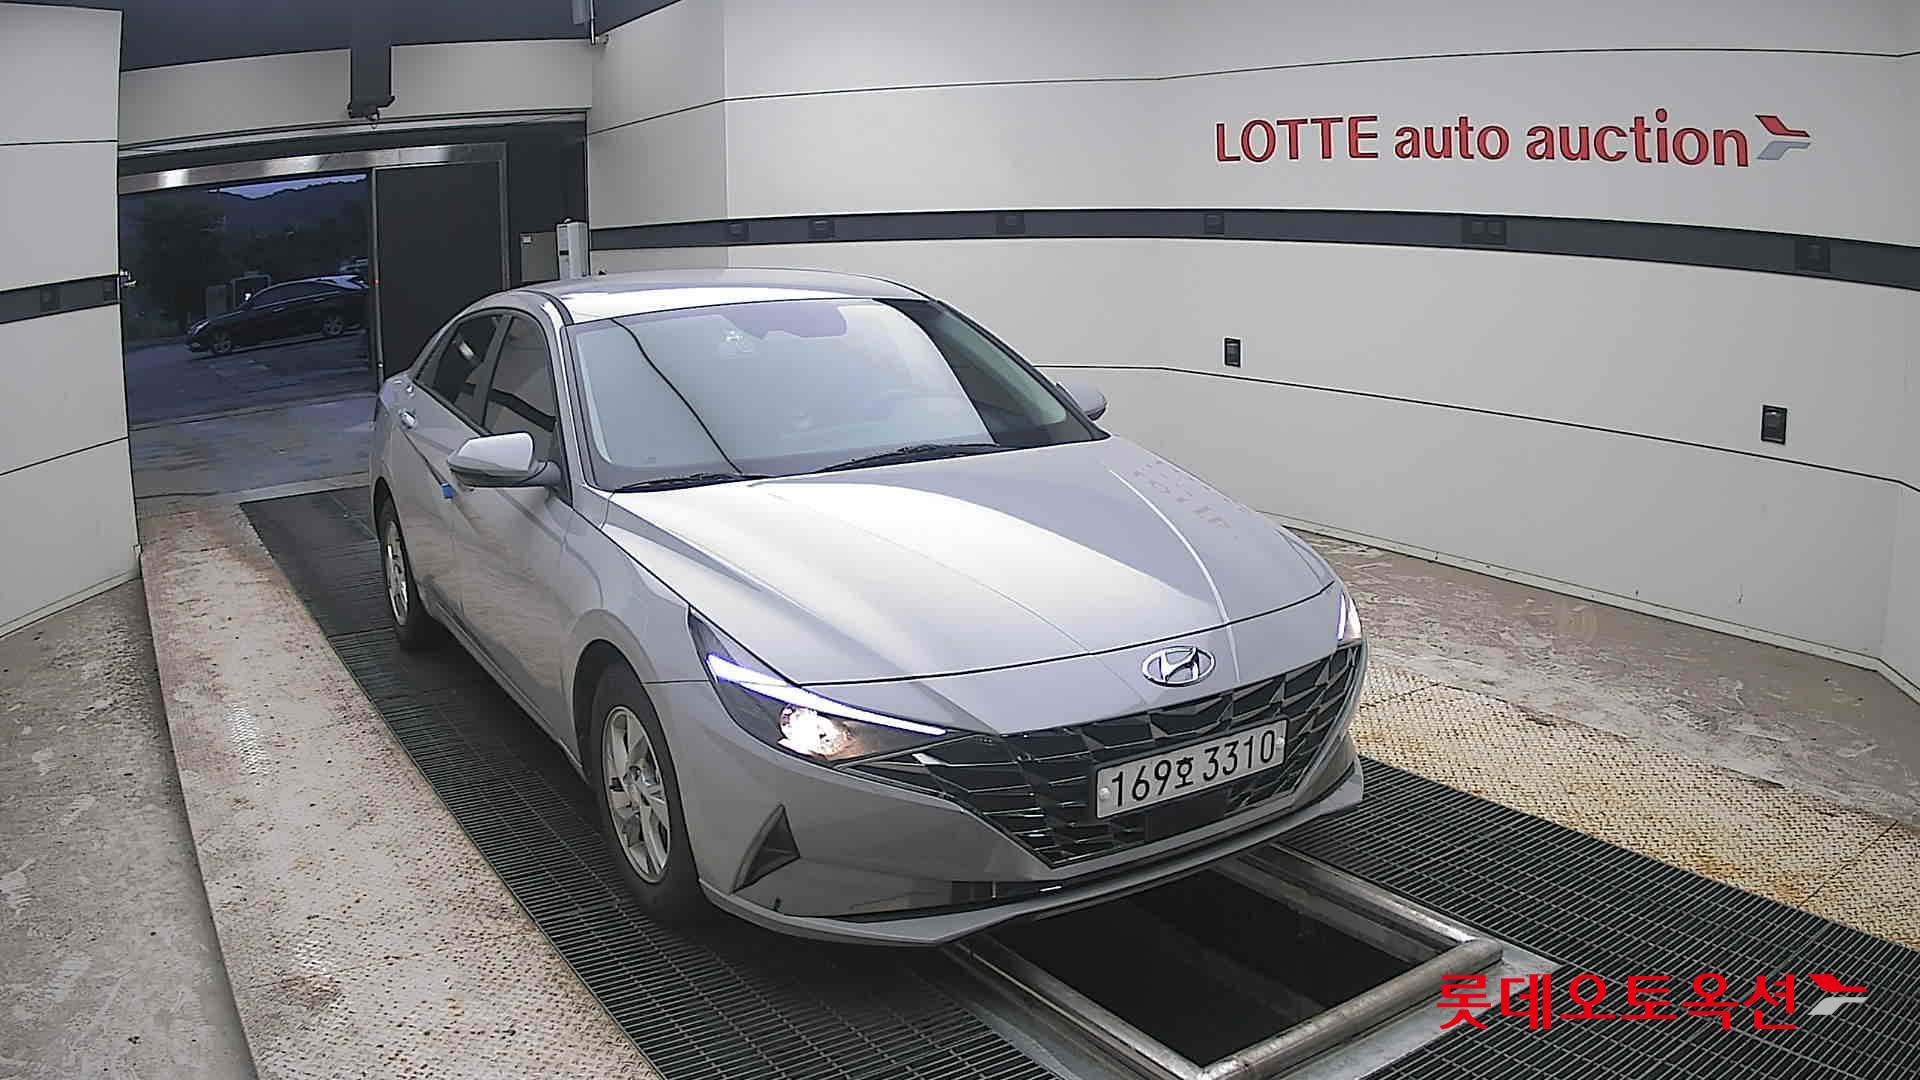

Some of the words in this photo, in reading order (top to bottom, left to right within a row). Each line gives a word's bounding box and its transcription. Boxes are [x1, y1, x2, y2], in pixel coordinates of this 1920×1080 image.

[1215, 115, 1379, 162] LOTTE
[1394, 115, 1511, 160] auto
[1525, 108, 1750, 167] auction
